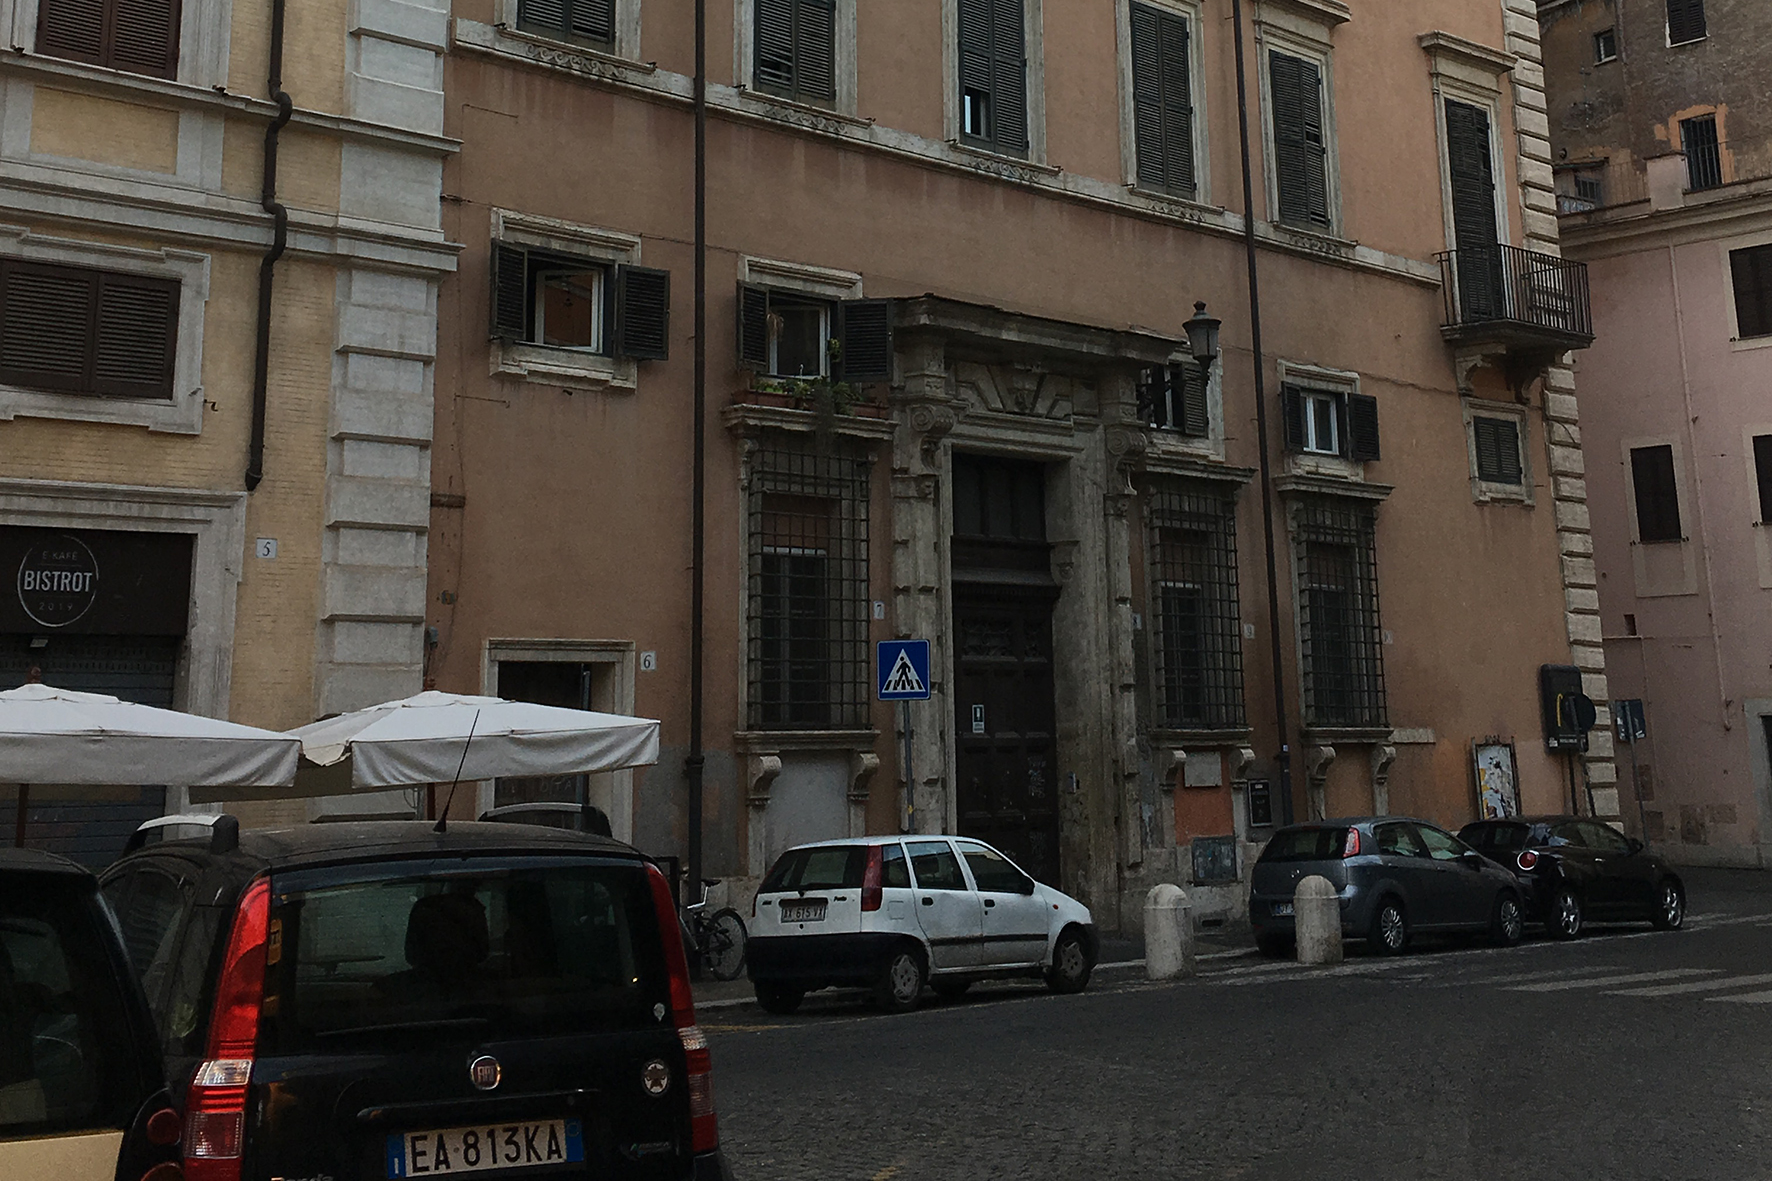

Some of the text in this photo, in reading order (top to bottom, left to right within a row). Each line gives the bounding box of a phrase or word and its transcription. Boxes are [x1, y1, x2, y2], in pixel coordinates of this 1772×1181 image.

[262, 541, 271, 557] 5
[24, 570, 93, 592] BISTROT
[39, 602, 73, 611] 2019
[643, 654, 652, 669] 6
